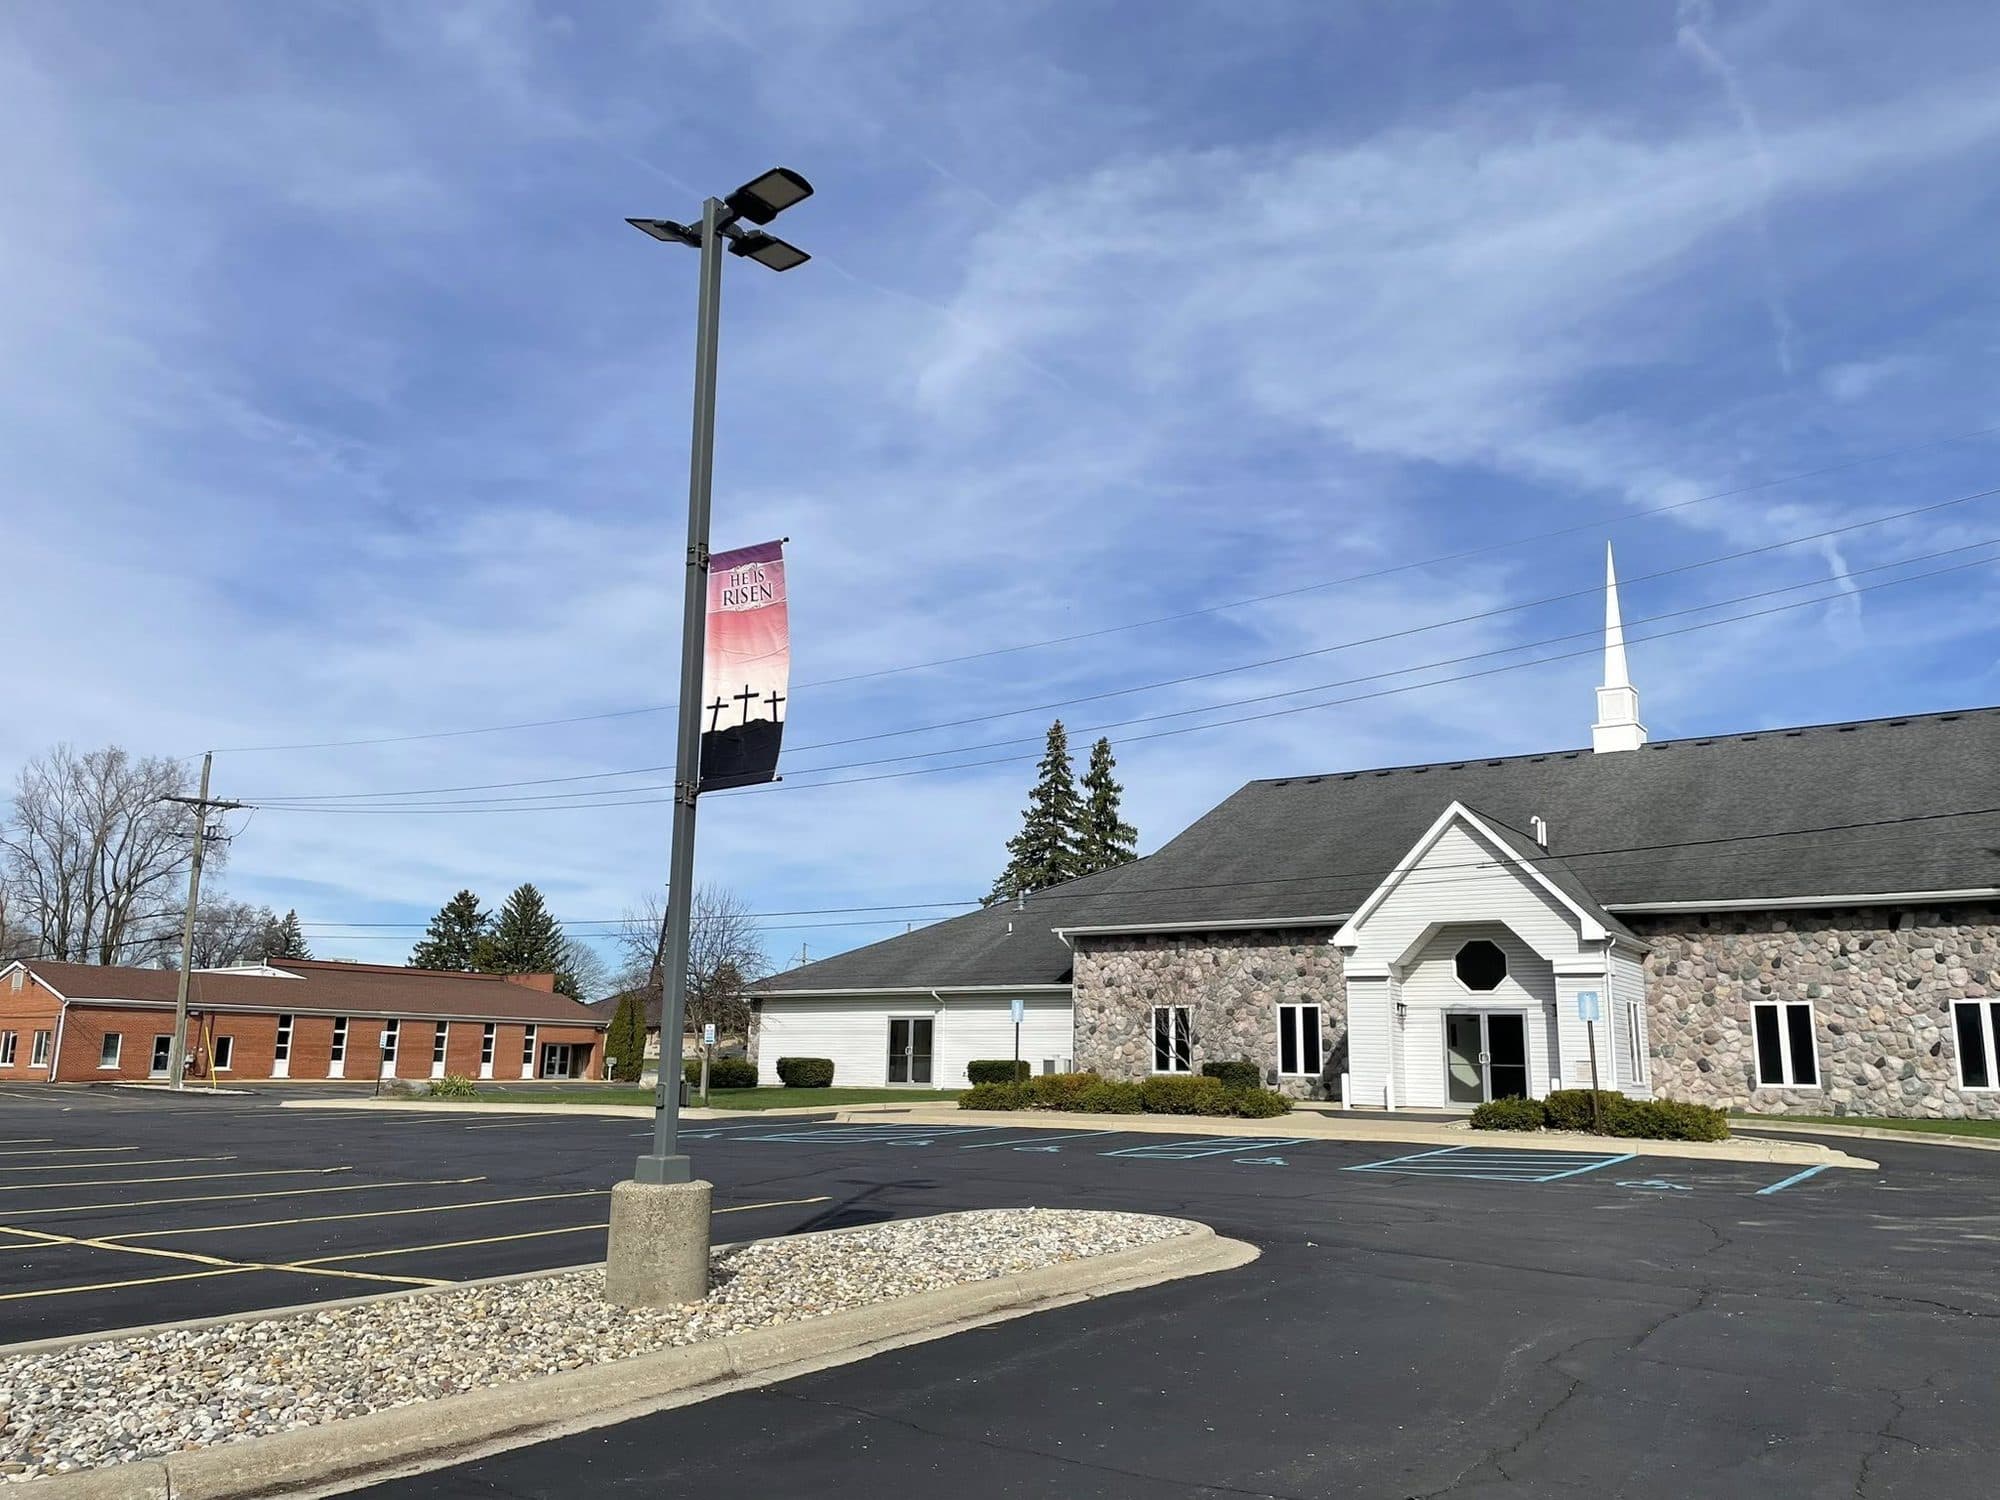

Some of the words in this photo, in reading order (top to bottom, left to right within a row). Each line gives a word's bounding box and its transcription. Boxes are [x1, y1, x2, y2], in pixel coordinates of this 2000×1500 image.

[730, 572, 749, 587] HE
[754, 569, 765, 583] IS
[723, 583, 772, 606] RISEN
